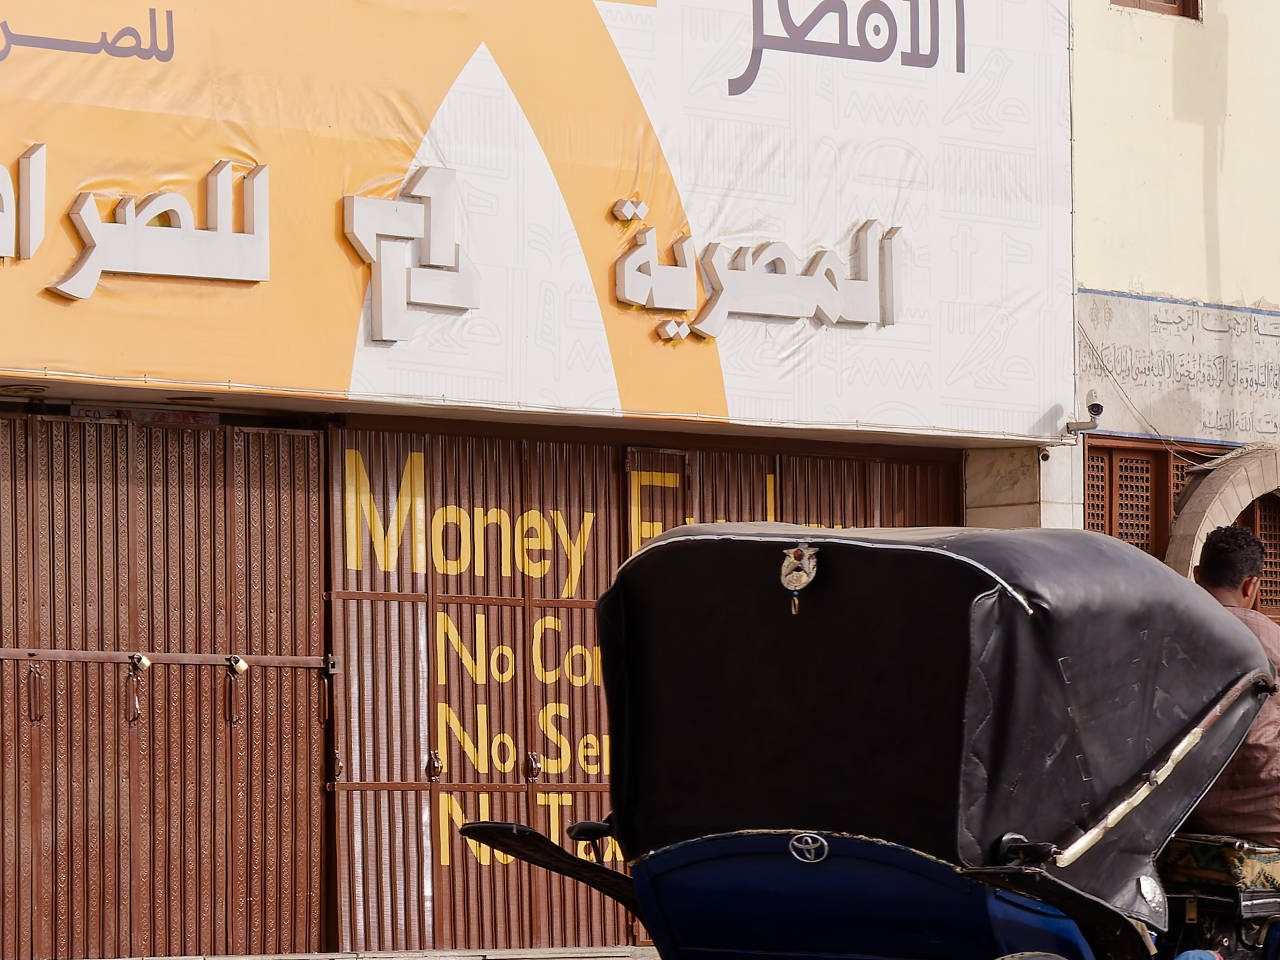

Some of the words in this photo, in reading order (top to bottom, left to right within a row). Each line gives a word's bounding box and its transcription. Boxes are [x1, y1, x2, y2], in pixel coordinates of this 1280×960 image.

[612, 195, 903, 345] المصرية
[345, 449, 596, 598] Money
[436, 612, 515, 686] No
[532, 616, 602, 687] Co
[438, 703, 517, 774] No
